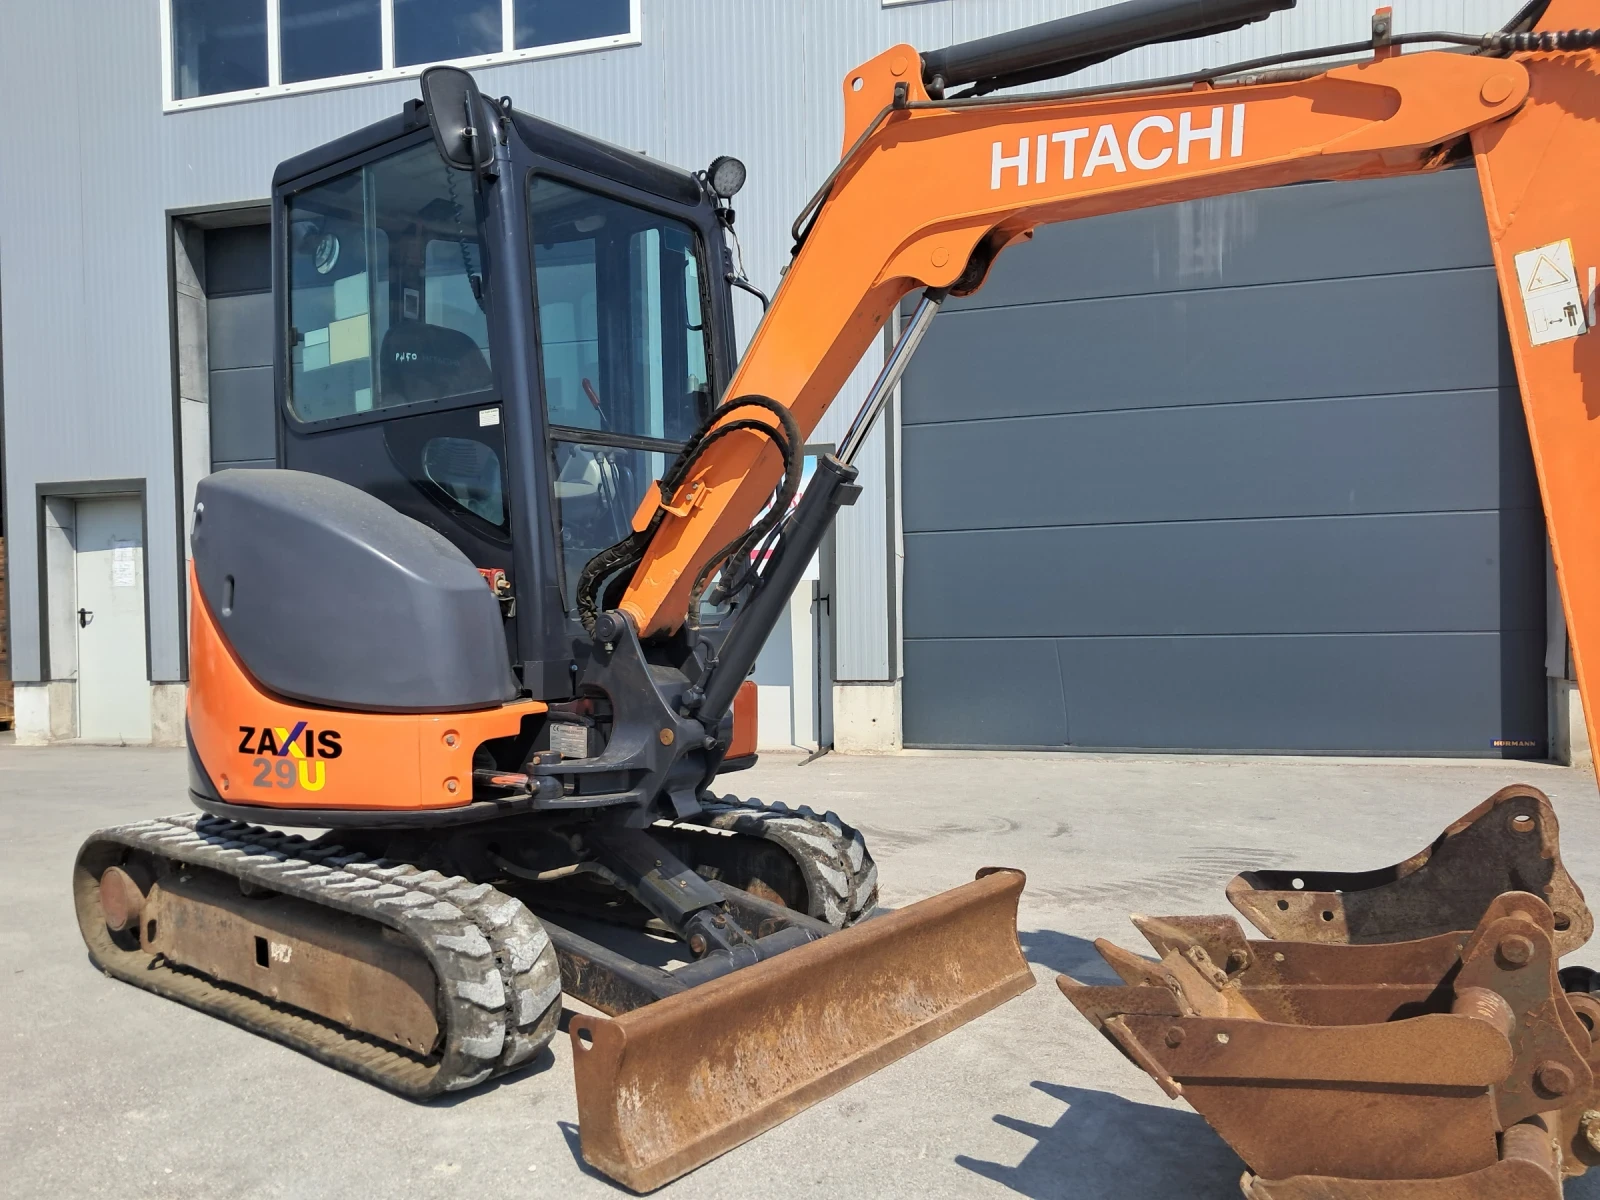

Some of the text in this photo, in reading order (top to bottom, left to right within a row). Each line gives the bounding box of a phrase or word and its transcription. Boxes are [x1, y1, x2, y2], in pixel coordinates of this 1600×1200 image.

[991, 104, 1245, 190] HITACHI
[238, 721, 342, 759] ZAXIS
[253, 758, 326, 791] 29U
